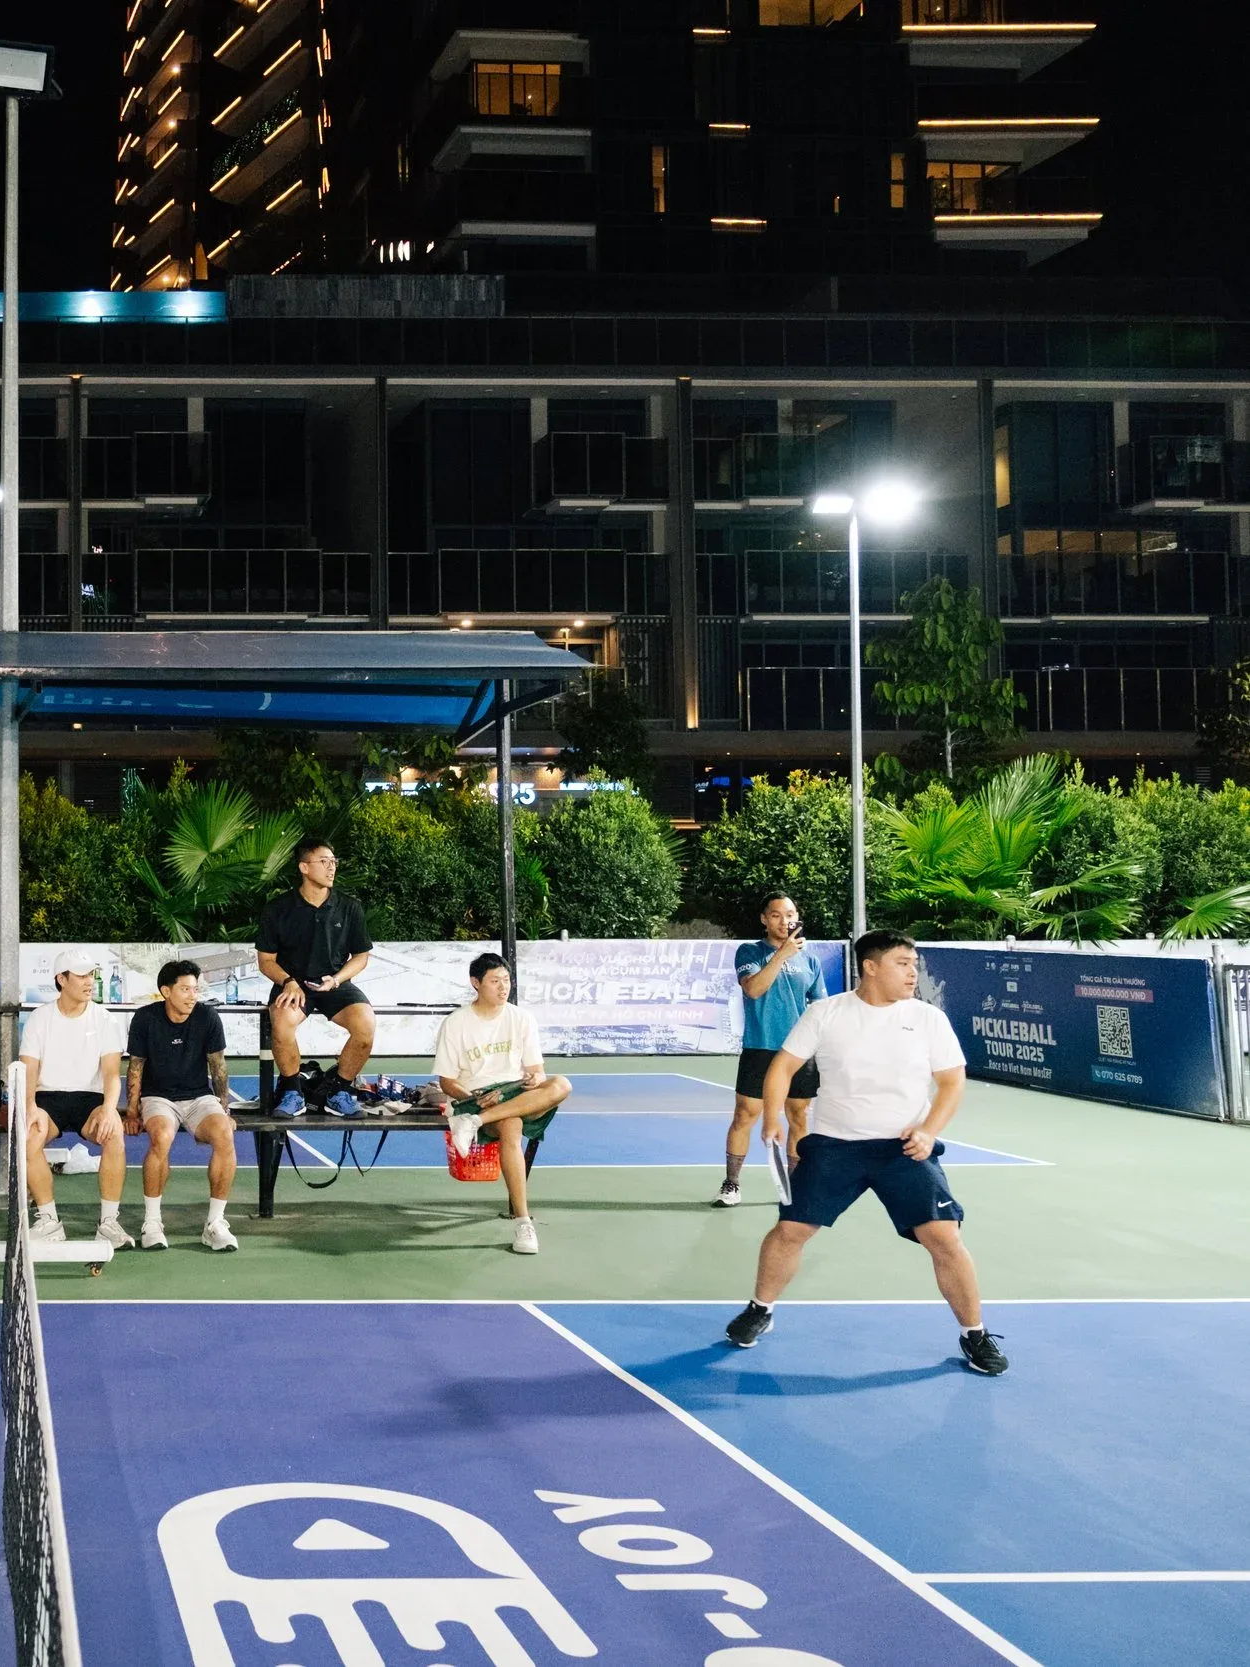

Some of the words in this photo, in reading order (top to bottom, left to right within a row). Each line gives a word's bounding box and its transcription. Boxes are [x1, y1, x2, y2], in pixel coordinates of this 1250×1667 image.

[524, 981, 708, 1002] PICKLEBALL
[972, 1016, 1058, 1046] PICKLEBALL
[984, 1040, 1015, 1059] TOUR
[1016, 1044, 1045, 1063] 2025
[1101, 1070, 1114, 1081] 070
[1114, 1072, 1127, 1083] 625
[1127, 1074, 1143, 1085] 6789
